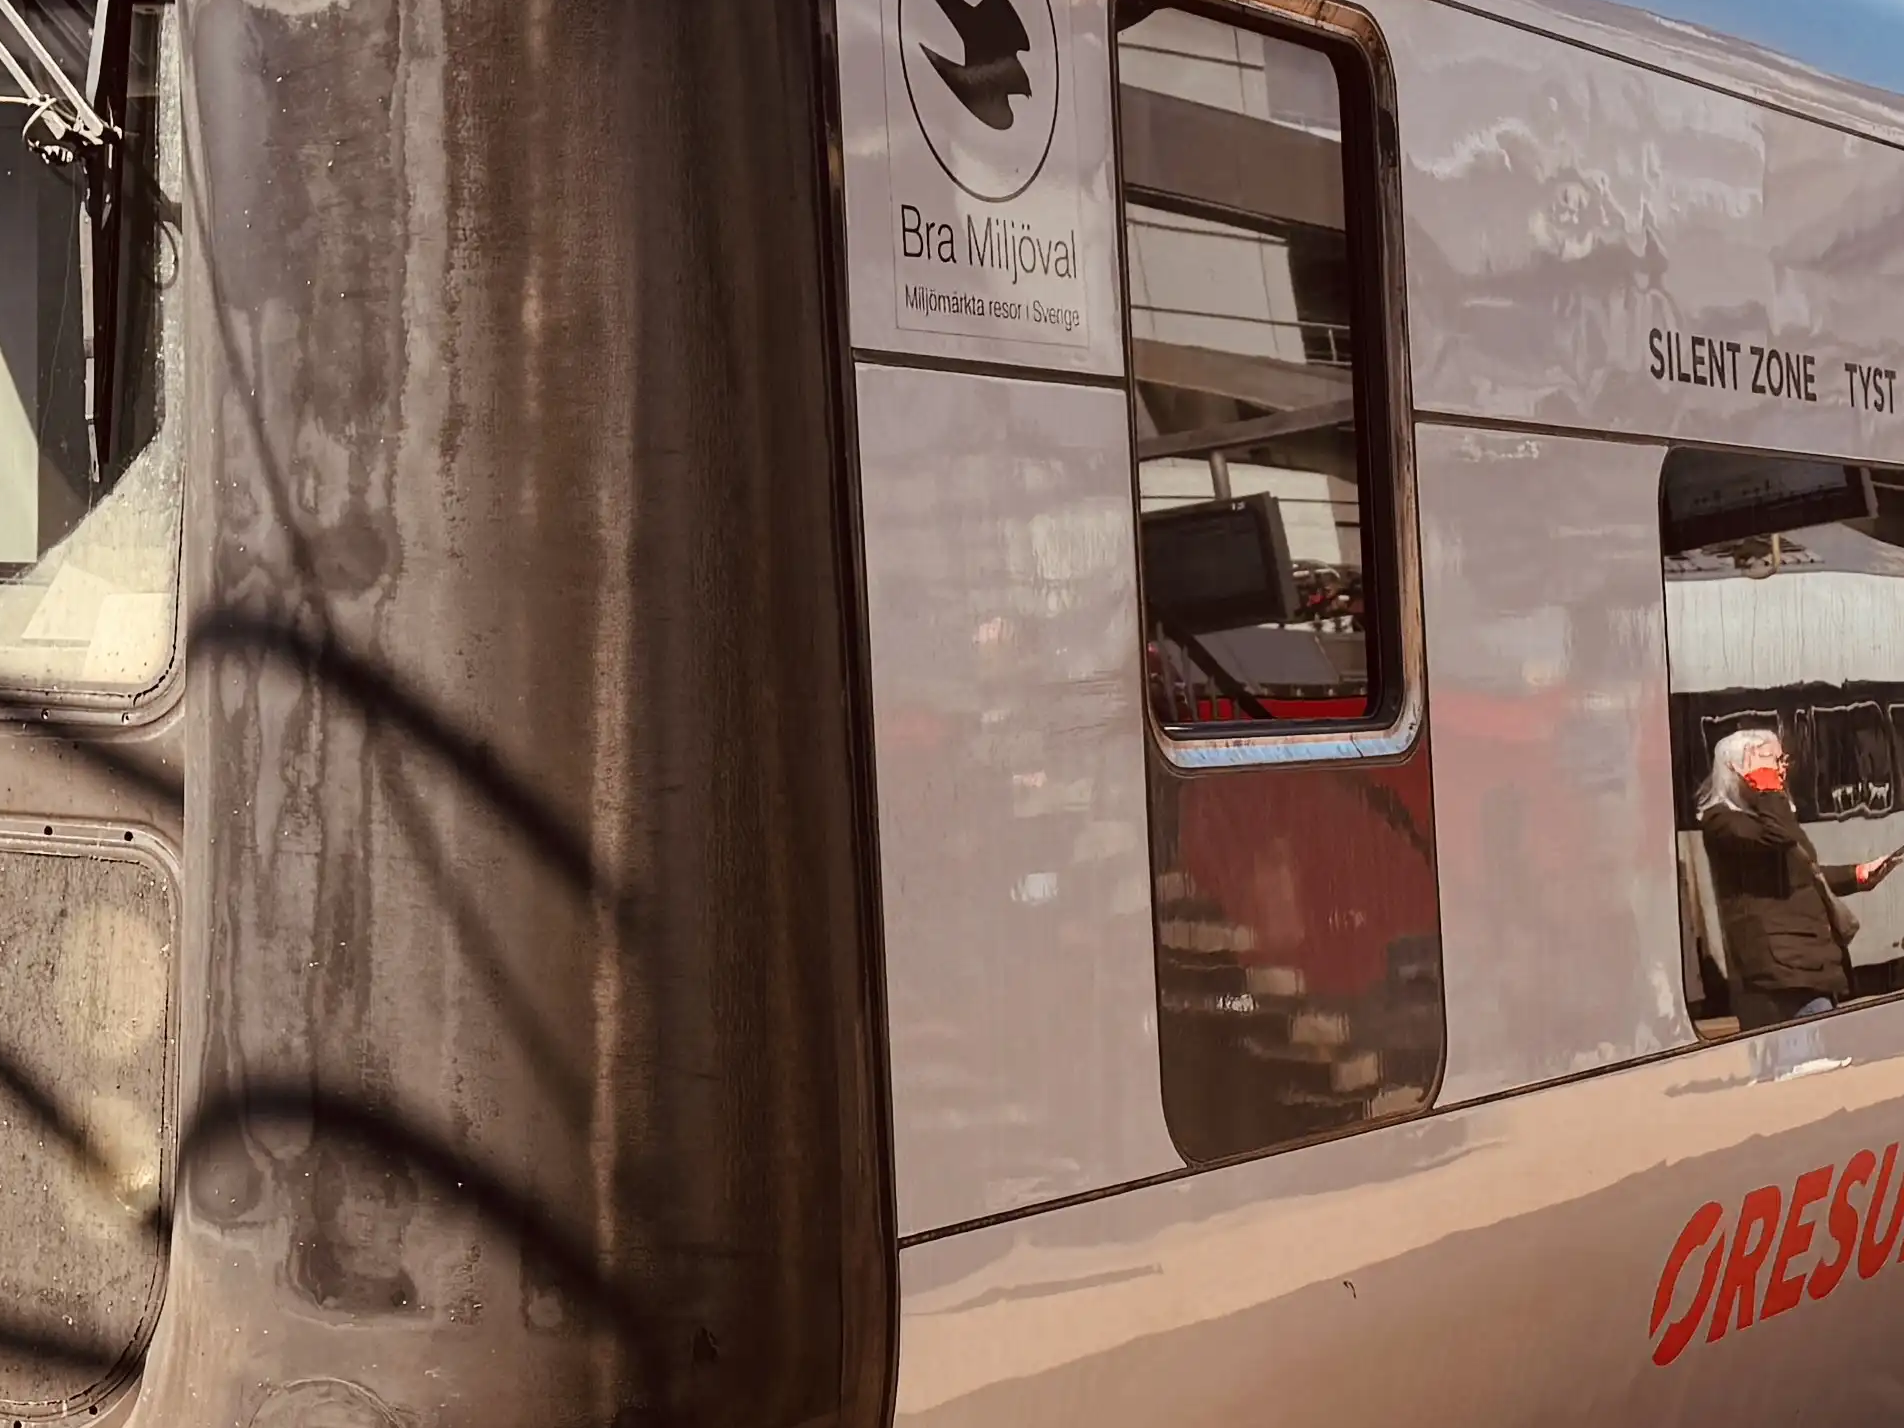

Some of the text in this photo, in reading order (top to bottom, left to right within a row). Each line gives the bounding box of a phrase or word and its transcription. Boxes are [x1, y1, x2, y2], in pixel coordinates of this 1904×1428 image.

[901, 203, 1078, 285] Bra Miljöval
[904, 283, 985, 317] Miljömärkta
[989, 300, 1022, 321] resor
[1032, 299, 1081, 332] Sverige
[1648, 327, 1743, 391] SILENT
[1750, 344, 1819, 403] ZONE
[1844, 362, 1898, 414] TYST
